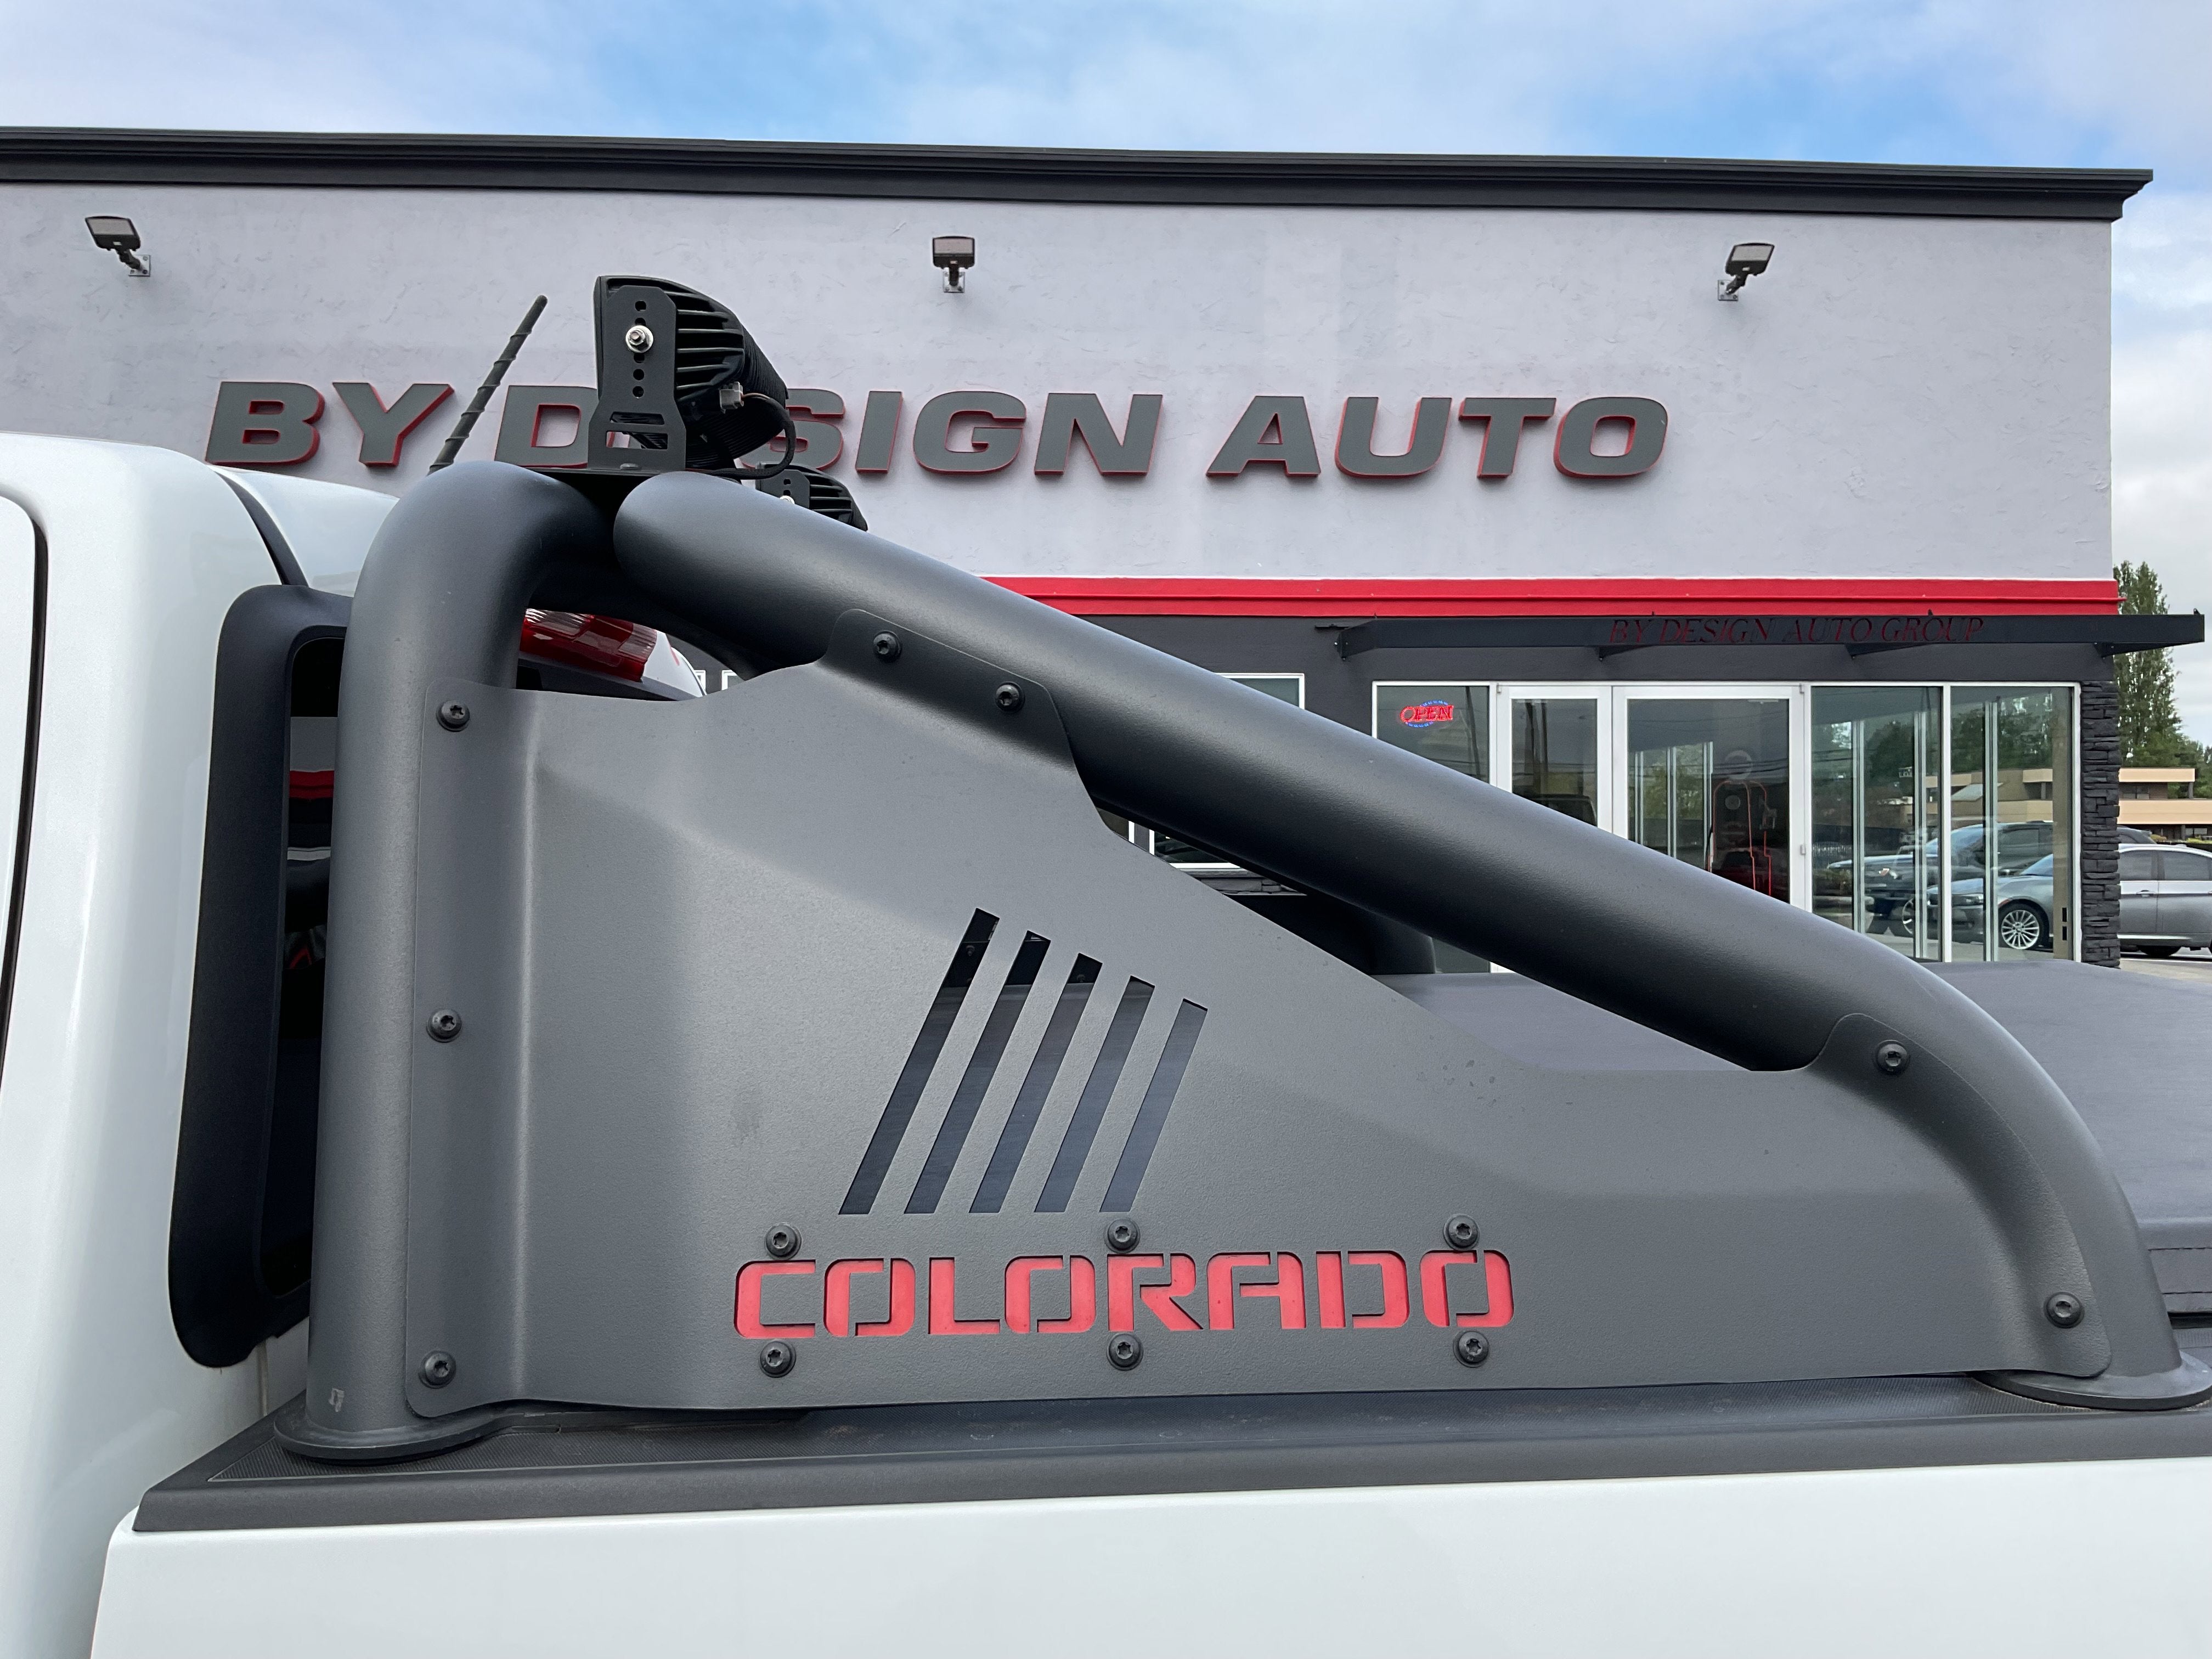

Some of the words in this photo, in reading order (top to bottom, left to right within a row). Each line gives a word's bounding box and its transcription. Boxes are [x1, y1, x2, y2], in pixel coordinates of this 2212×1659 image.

[205, 381, 454, 467] BY
[494, 385, 1164, 476] DSIGN
[1205, 395, 1669, 479] AUTO
[1609, 618, 1656, 643] BY
[1658, 618, 1777, 643] DESIGN
[1781, 617, 1873, 642] AUTO
[1880, 617, 1984, 642] GROUP
[1400, 705, 1454, 723] OPEN
[733, 1249, 1515, 1339] COLORADO
